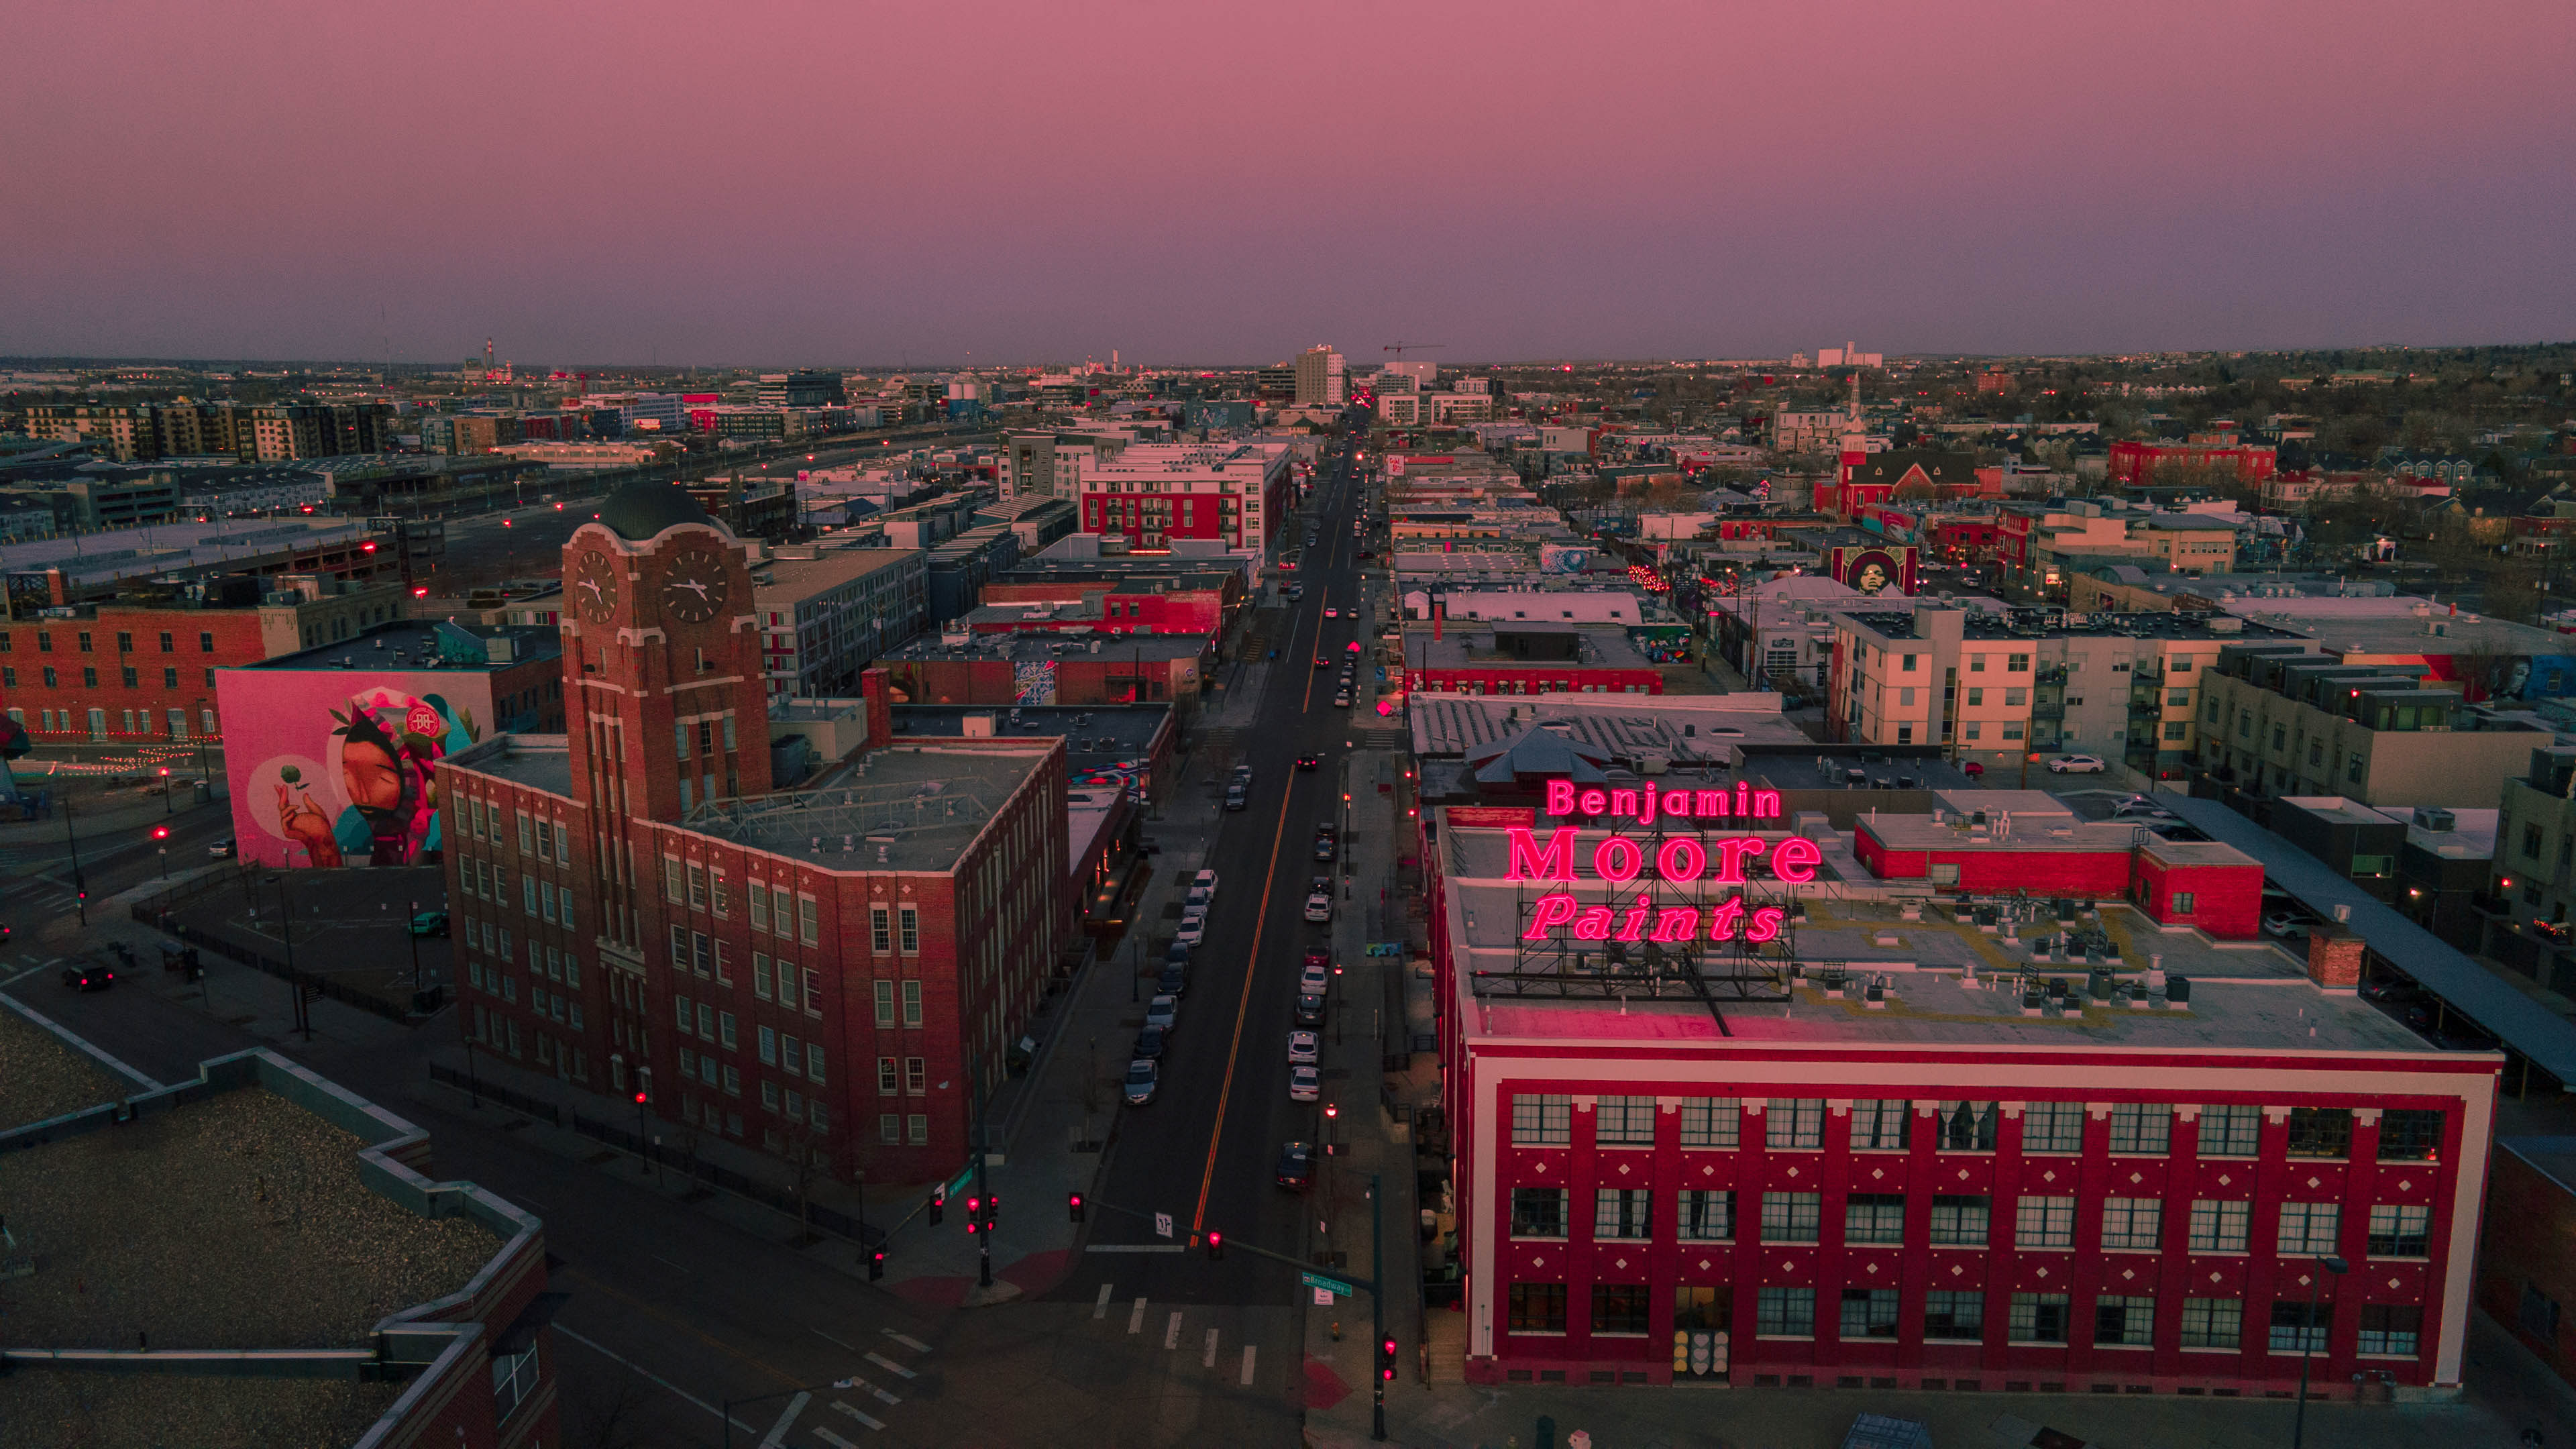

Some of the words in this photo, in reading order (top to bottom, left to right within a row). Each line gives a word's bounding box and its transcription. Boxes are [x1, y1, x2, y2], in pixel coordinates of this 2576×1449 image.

[1547, 780, 1782, 824] Benjamin
[1504, 825, 1823, 883] Moore
[1523, 894, 1784, 942] Paints
[1310, 1276, 1344, 1294] Broadway
